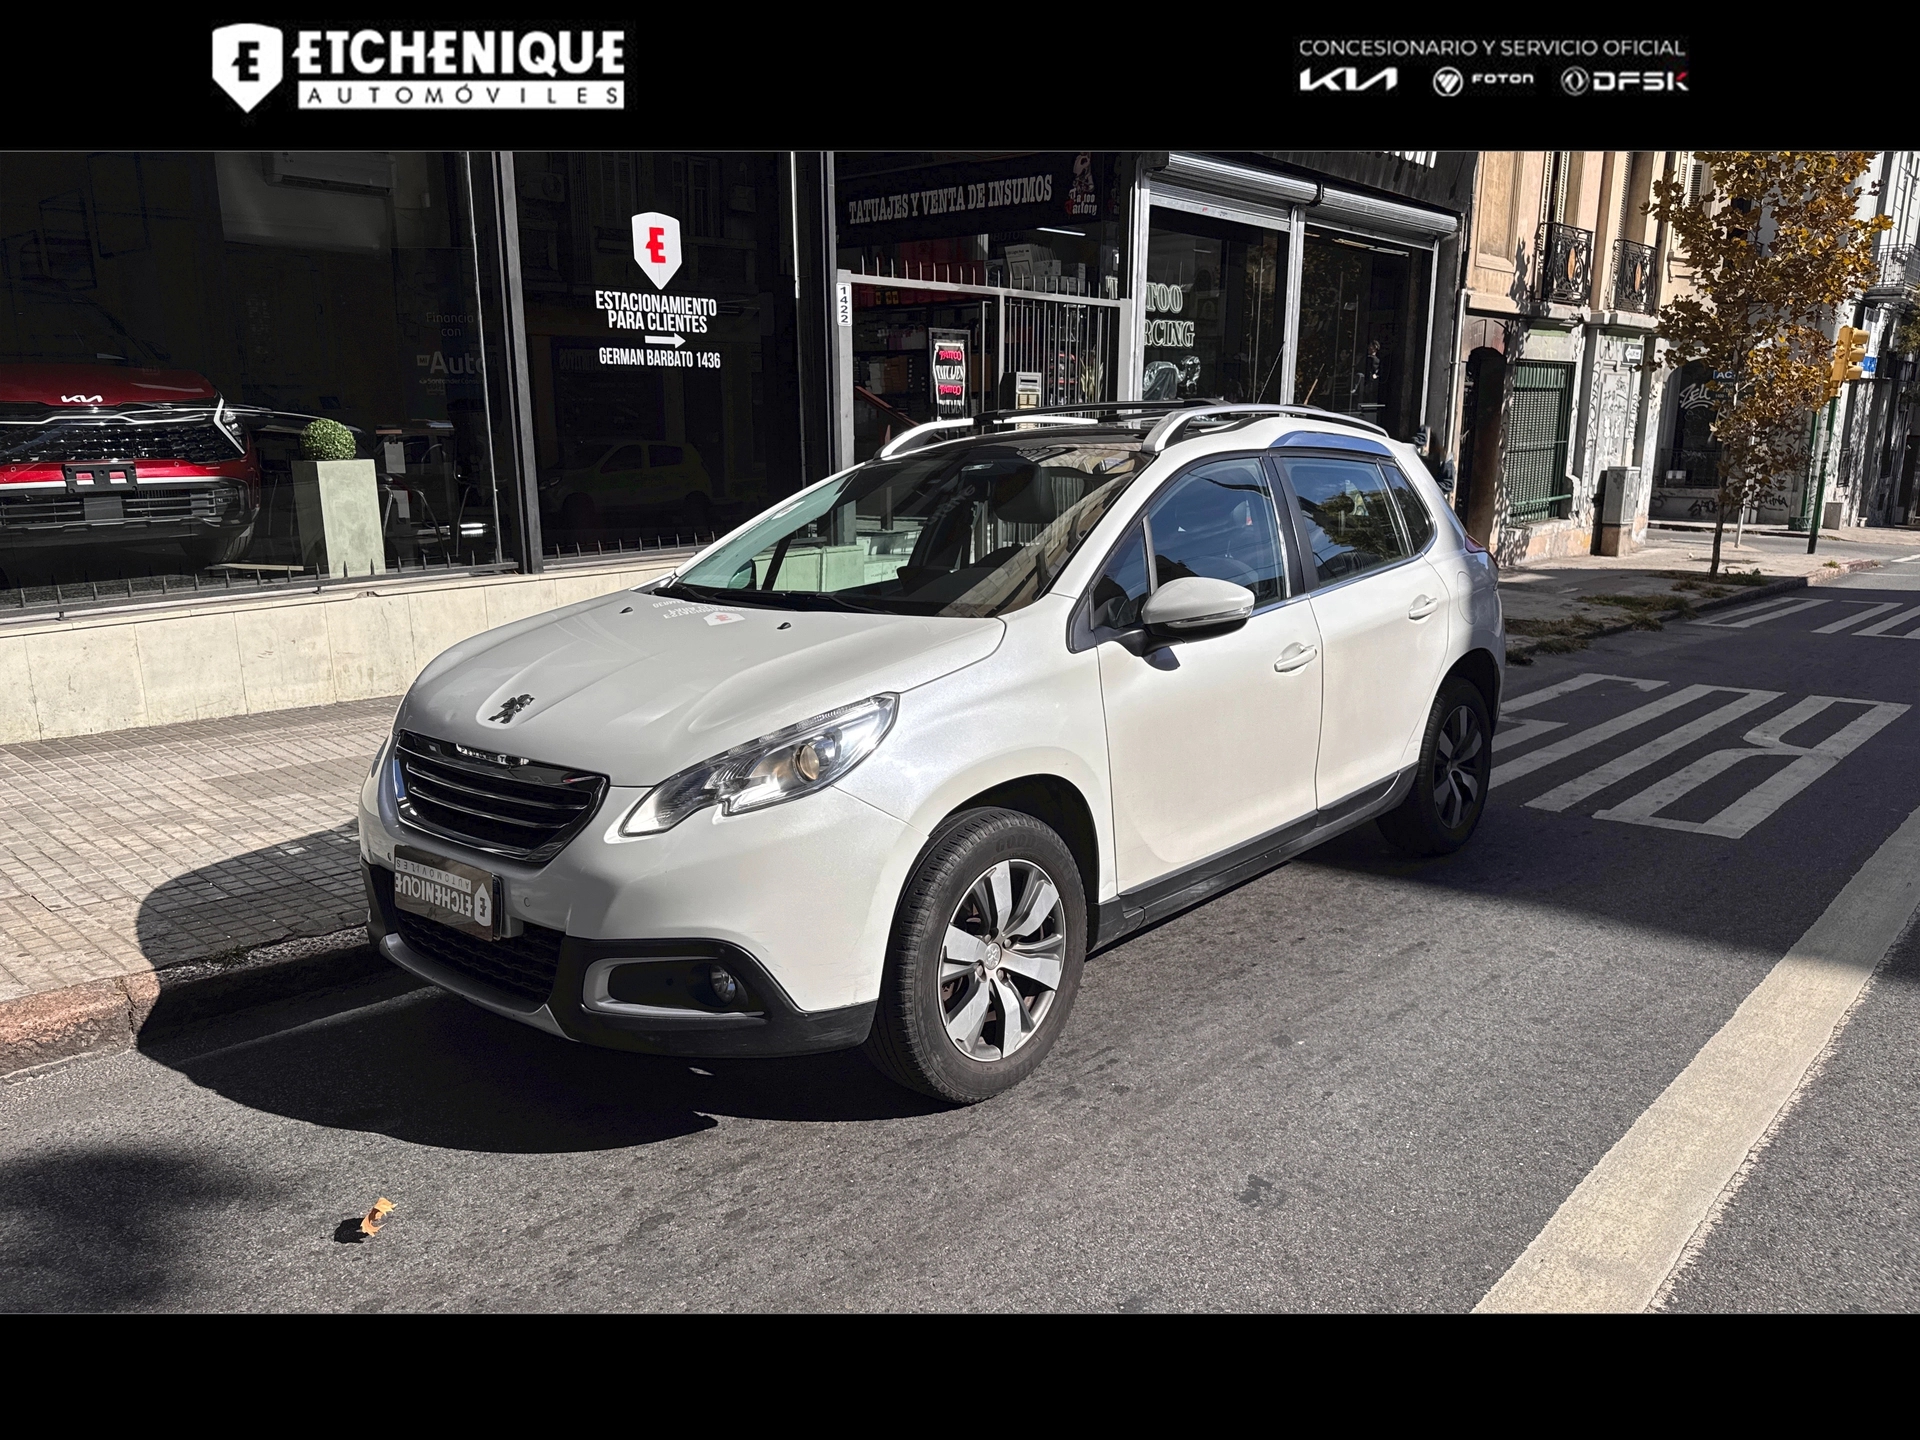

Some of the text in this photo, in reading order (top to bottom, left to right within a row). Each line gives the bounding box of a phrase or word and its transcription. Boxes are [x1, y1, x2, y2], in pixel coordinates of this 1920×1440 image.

[849, 174, 1053, 224] TATUAJES Y VENTA DE INSUMOS
[595, 289, 717, 317] ESTACIONAMIENTO
[839, 286, 849, 324] 1422
[441, 327, 462, 337] con
[607, 309, 708, 334] PARA CLIENTES
[599, 347, 645, 366] GERMAN
[646, 349, 693, 368] BARBATO
[696, 351, 721, 369] 1436
[61, 394, 103, 403] KIA
[395, 872, 473, 917] ETCHENIQUE
